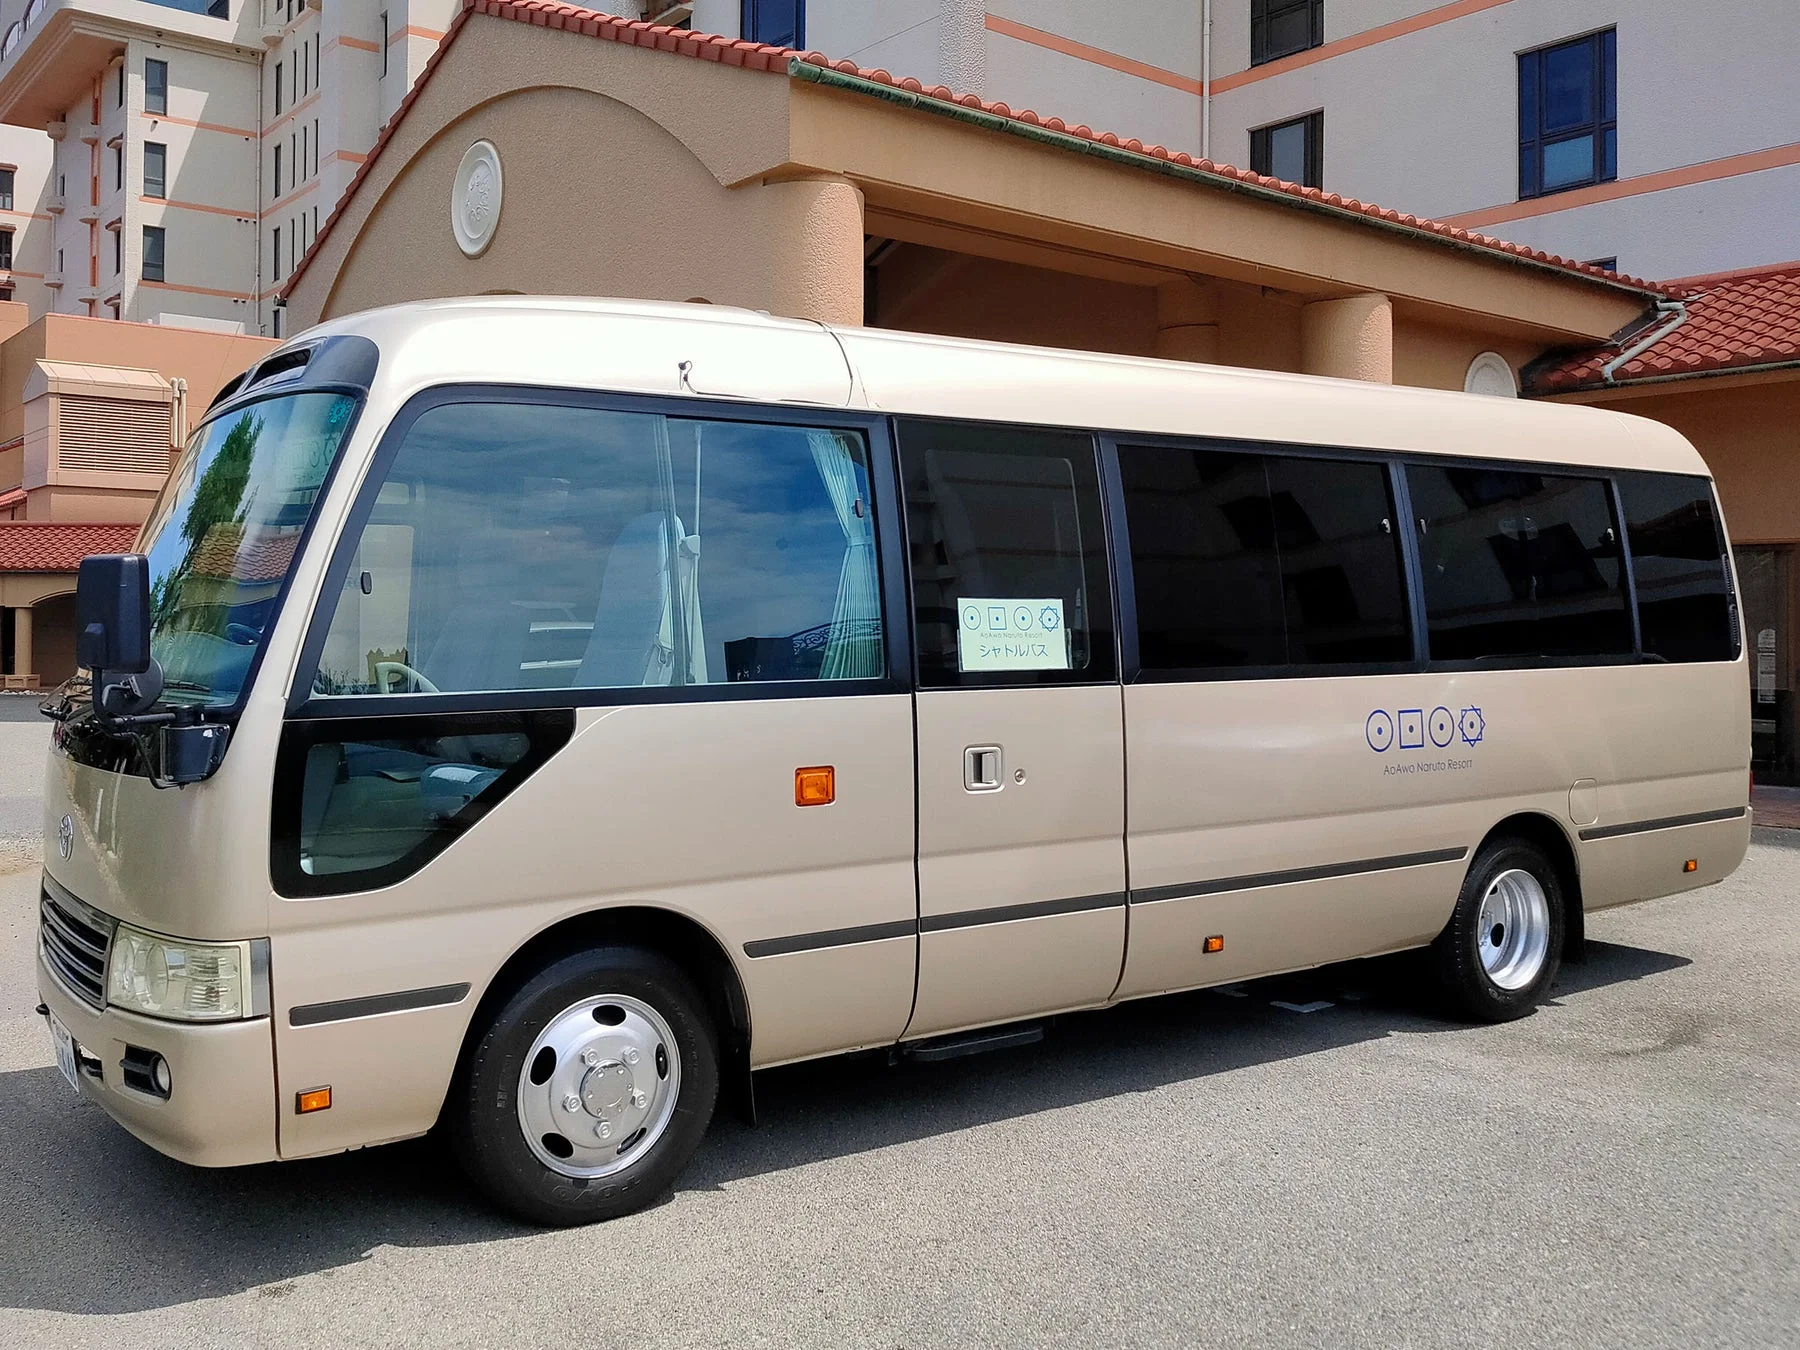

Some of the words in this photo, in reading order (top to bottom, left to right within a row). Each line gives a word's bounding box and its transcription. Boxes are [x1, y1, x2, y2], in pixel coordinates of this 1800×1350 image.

[979, 643, 1048, 658] シャトルバス
[1383, 763, 1415, 776] AoAwa
[1416, 761, 1446, 773] Naruto
[1447, 758, 1473, 770] Resort
